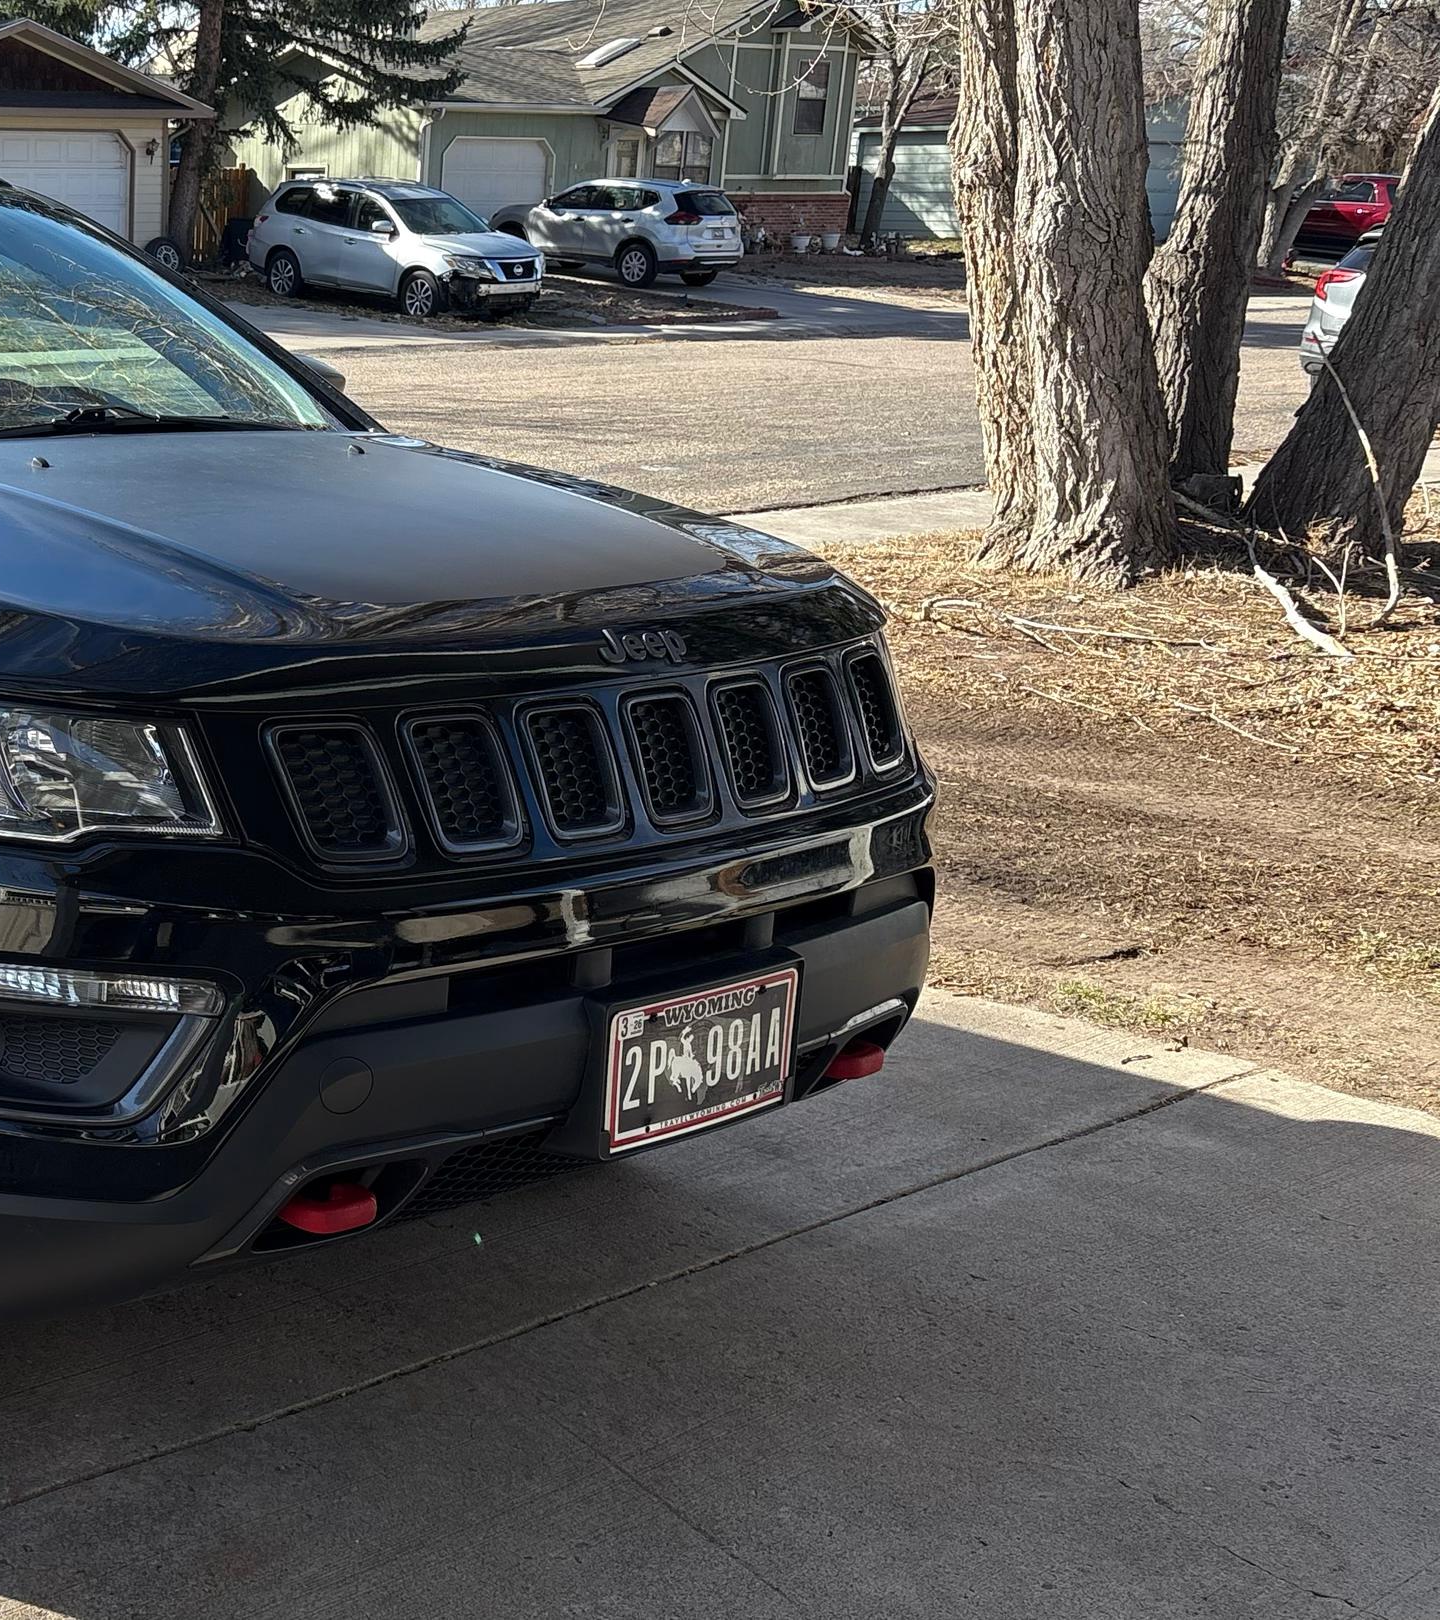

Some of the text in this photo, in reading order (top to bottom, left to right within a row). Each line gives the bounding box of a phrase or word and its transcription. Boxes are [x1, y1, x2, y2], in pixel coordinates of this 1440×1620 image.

[598, 628, 688, 664] Jeep
[663, 986, 756, 1027] WYOMING
[621, 1016, 629, 1038] 3
[622, 1007, 781, 1111] 2P 98AA
